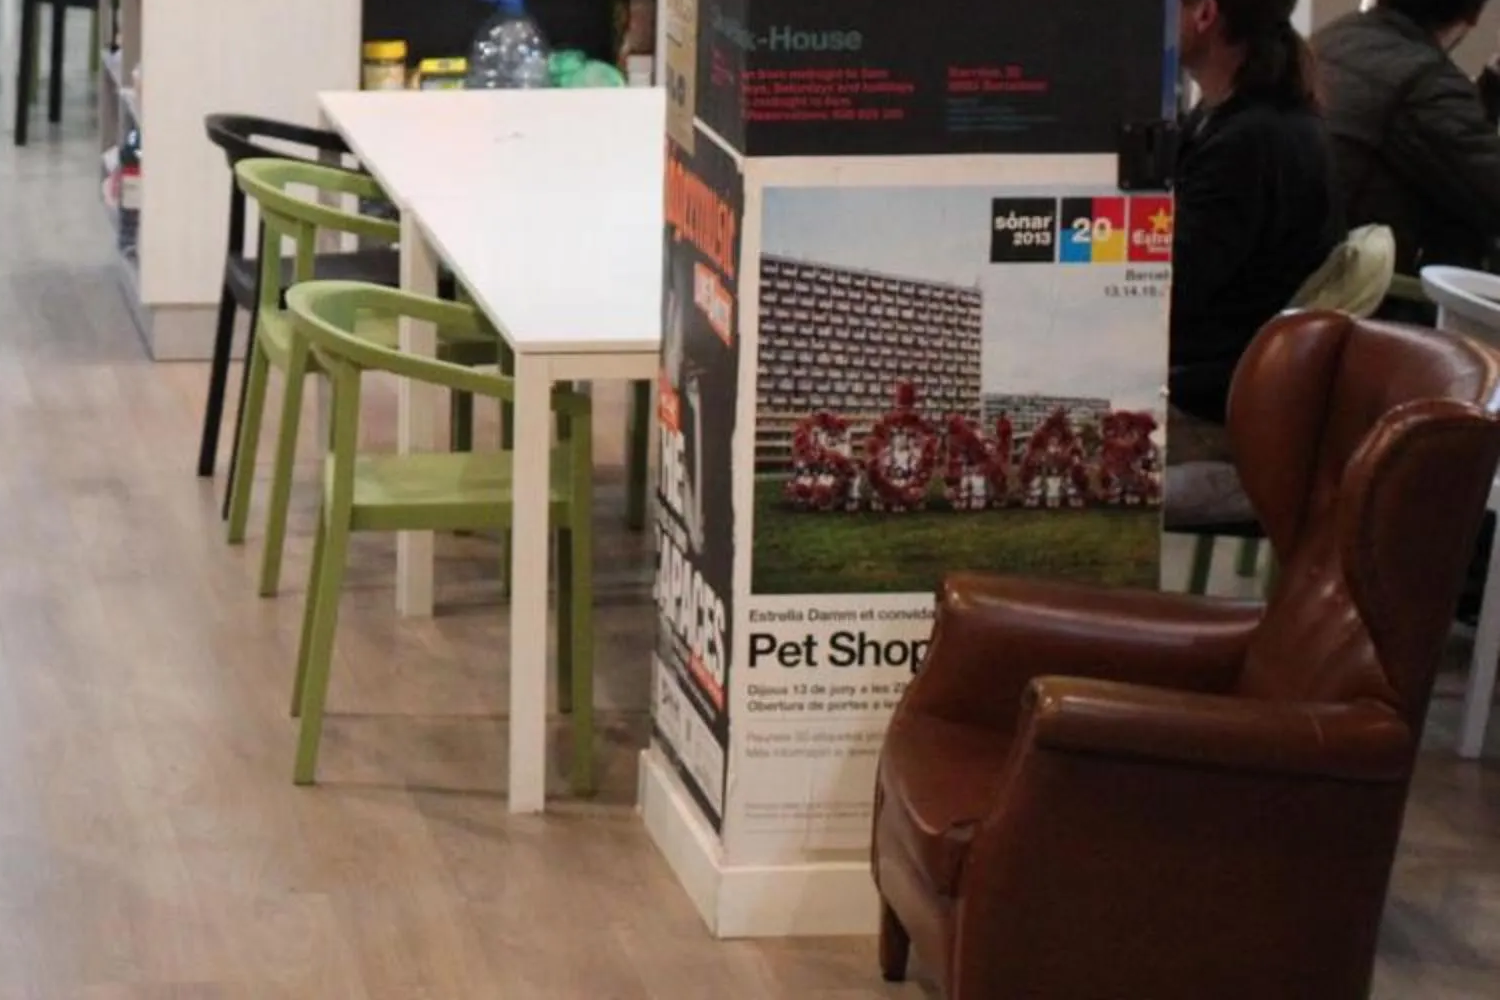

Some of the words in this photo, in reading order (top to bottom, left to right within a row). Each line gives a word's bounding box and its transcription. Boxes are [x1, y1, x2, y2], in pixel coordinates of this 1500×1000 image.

[1071, 218, 1113, 243] 20
[1013, 233, 1052, 246] 2013
[749, 609, 804, 622] Estrella
[808, 608, 857, 622] Damm
[860, 608, 874, 620] et
[748, 633, 818, 669] Pet
[828, 631, 932, 674] Shop
[810, 684, 827, 696] de
[746, 700, 804, 712] Obertura
[807, 700, 824, 711] de
[827, 701, 869, 714] portes
